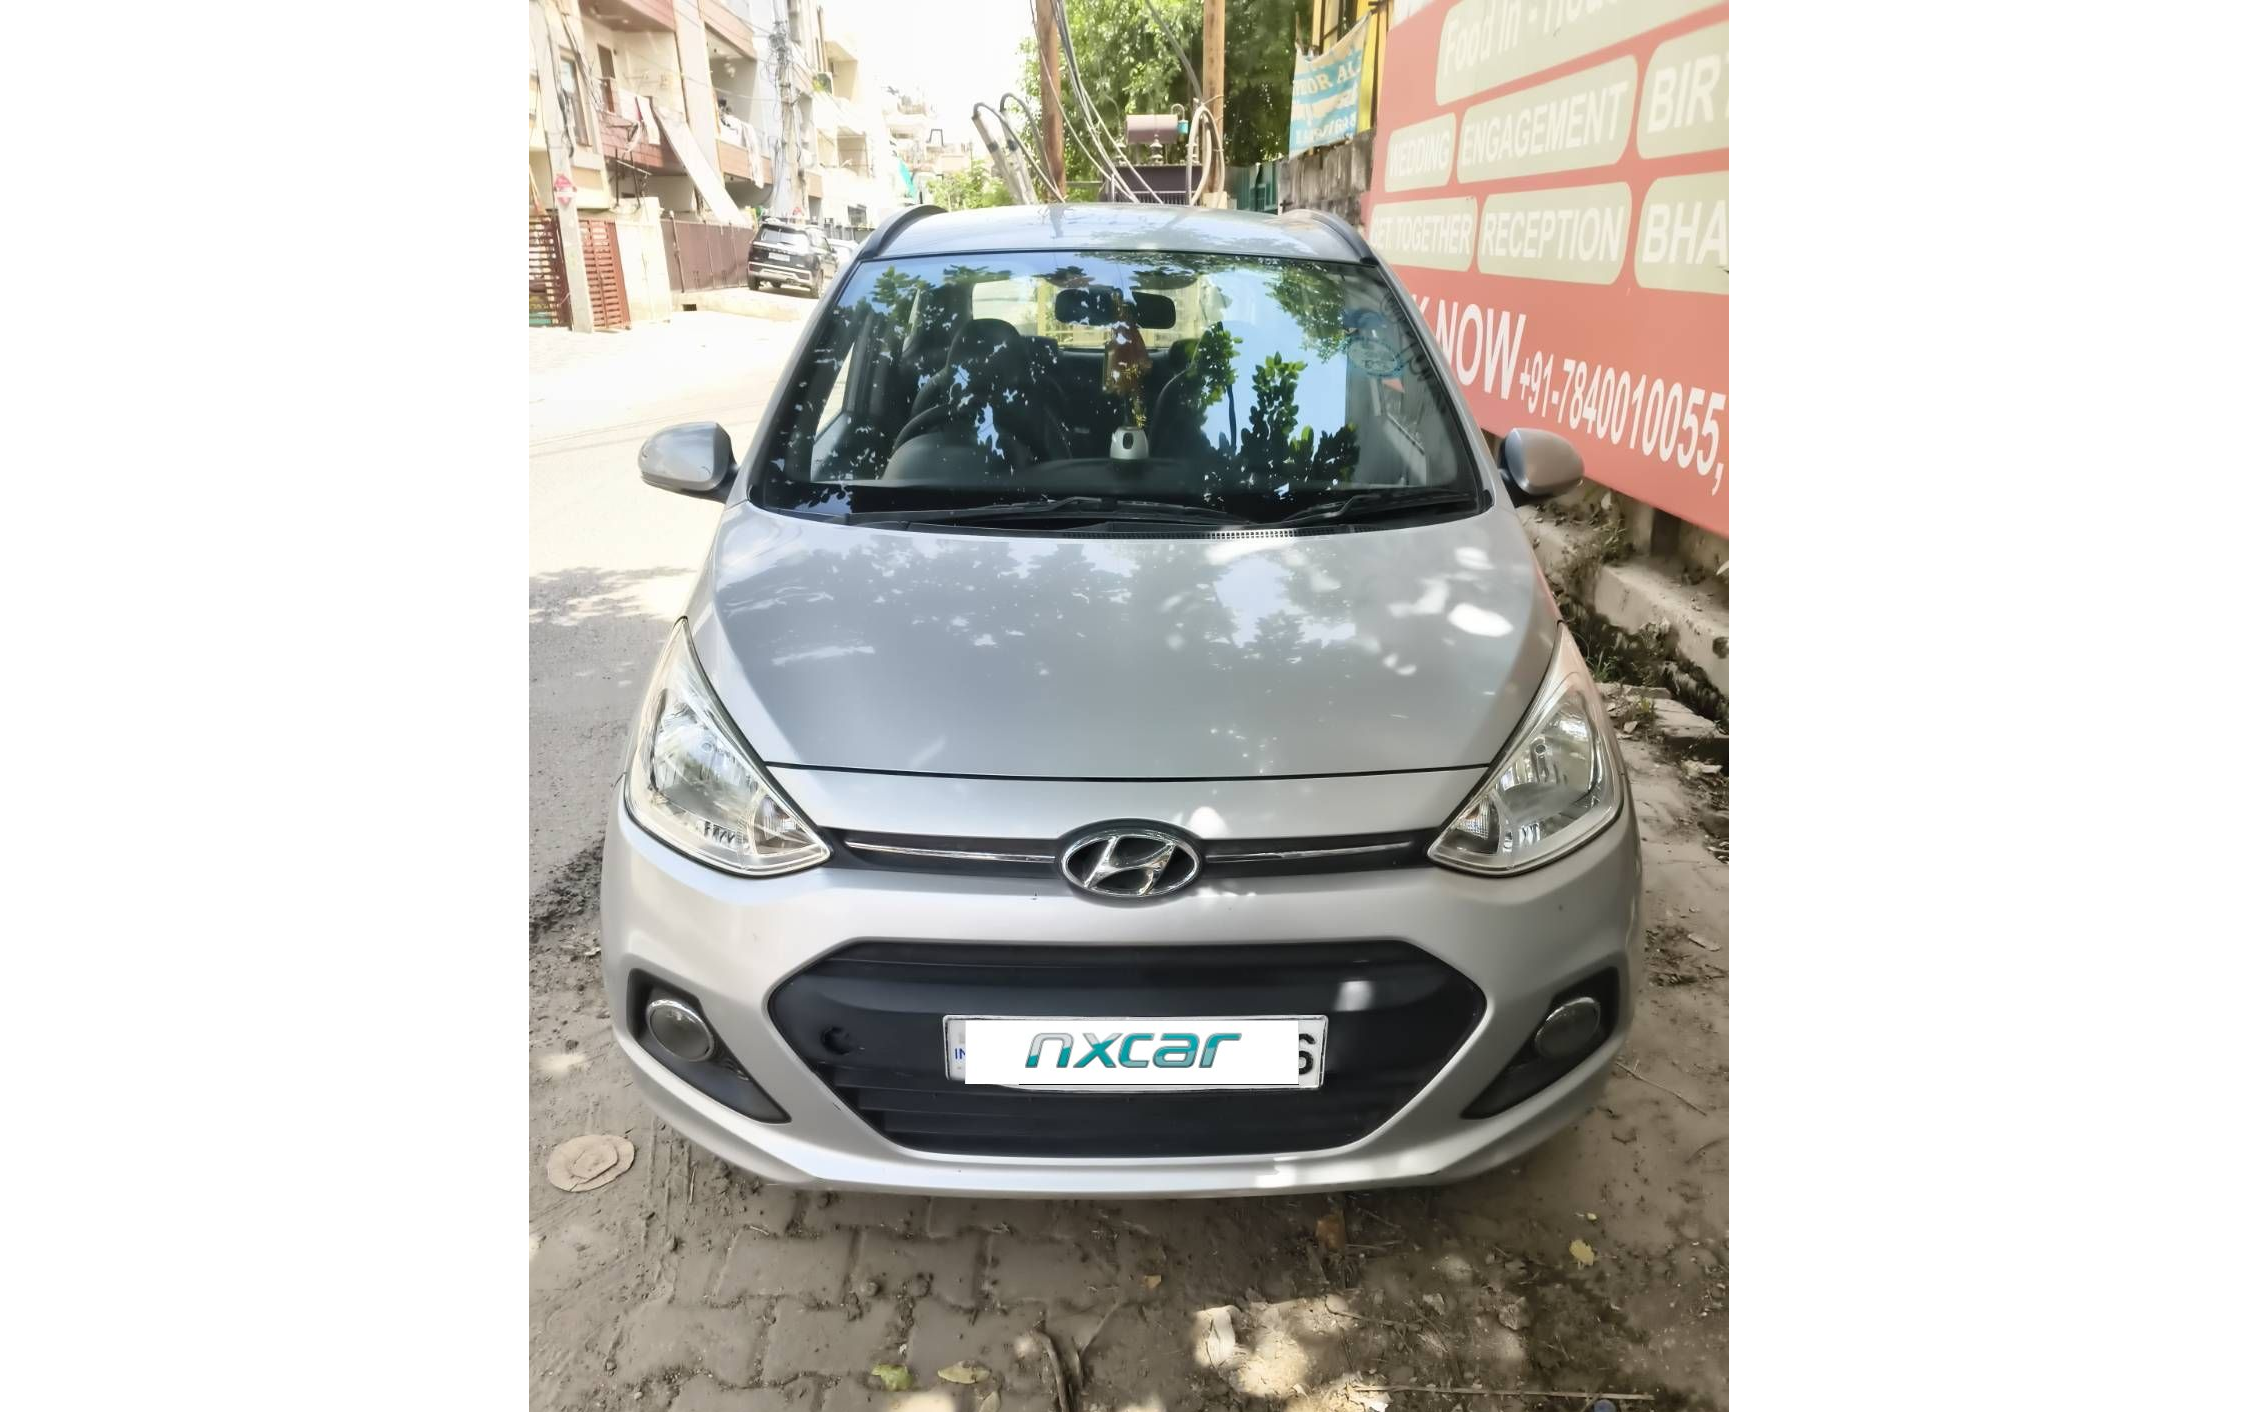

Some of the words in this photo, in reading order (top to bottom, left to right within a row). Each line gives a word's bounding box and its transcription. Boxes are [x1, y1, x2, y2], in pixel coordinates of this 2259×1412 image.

[1443, 0, 1496, 77] Food
[1461, 80, 1629, 166] ENGAGEMENT
[1647, 52, 1729, 133] BIR
[1389, 130, 1451, 176] WEDDING
[1393, 213, 1473, 255] TOGETHER
[1481, 206, 1625, 261] RECEPTION
[1433, 299, 1527, 400] NOW
